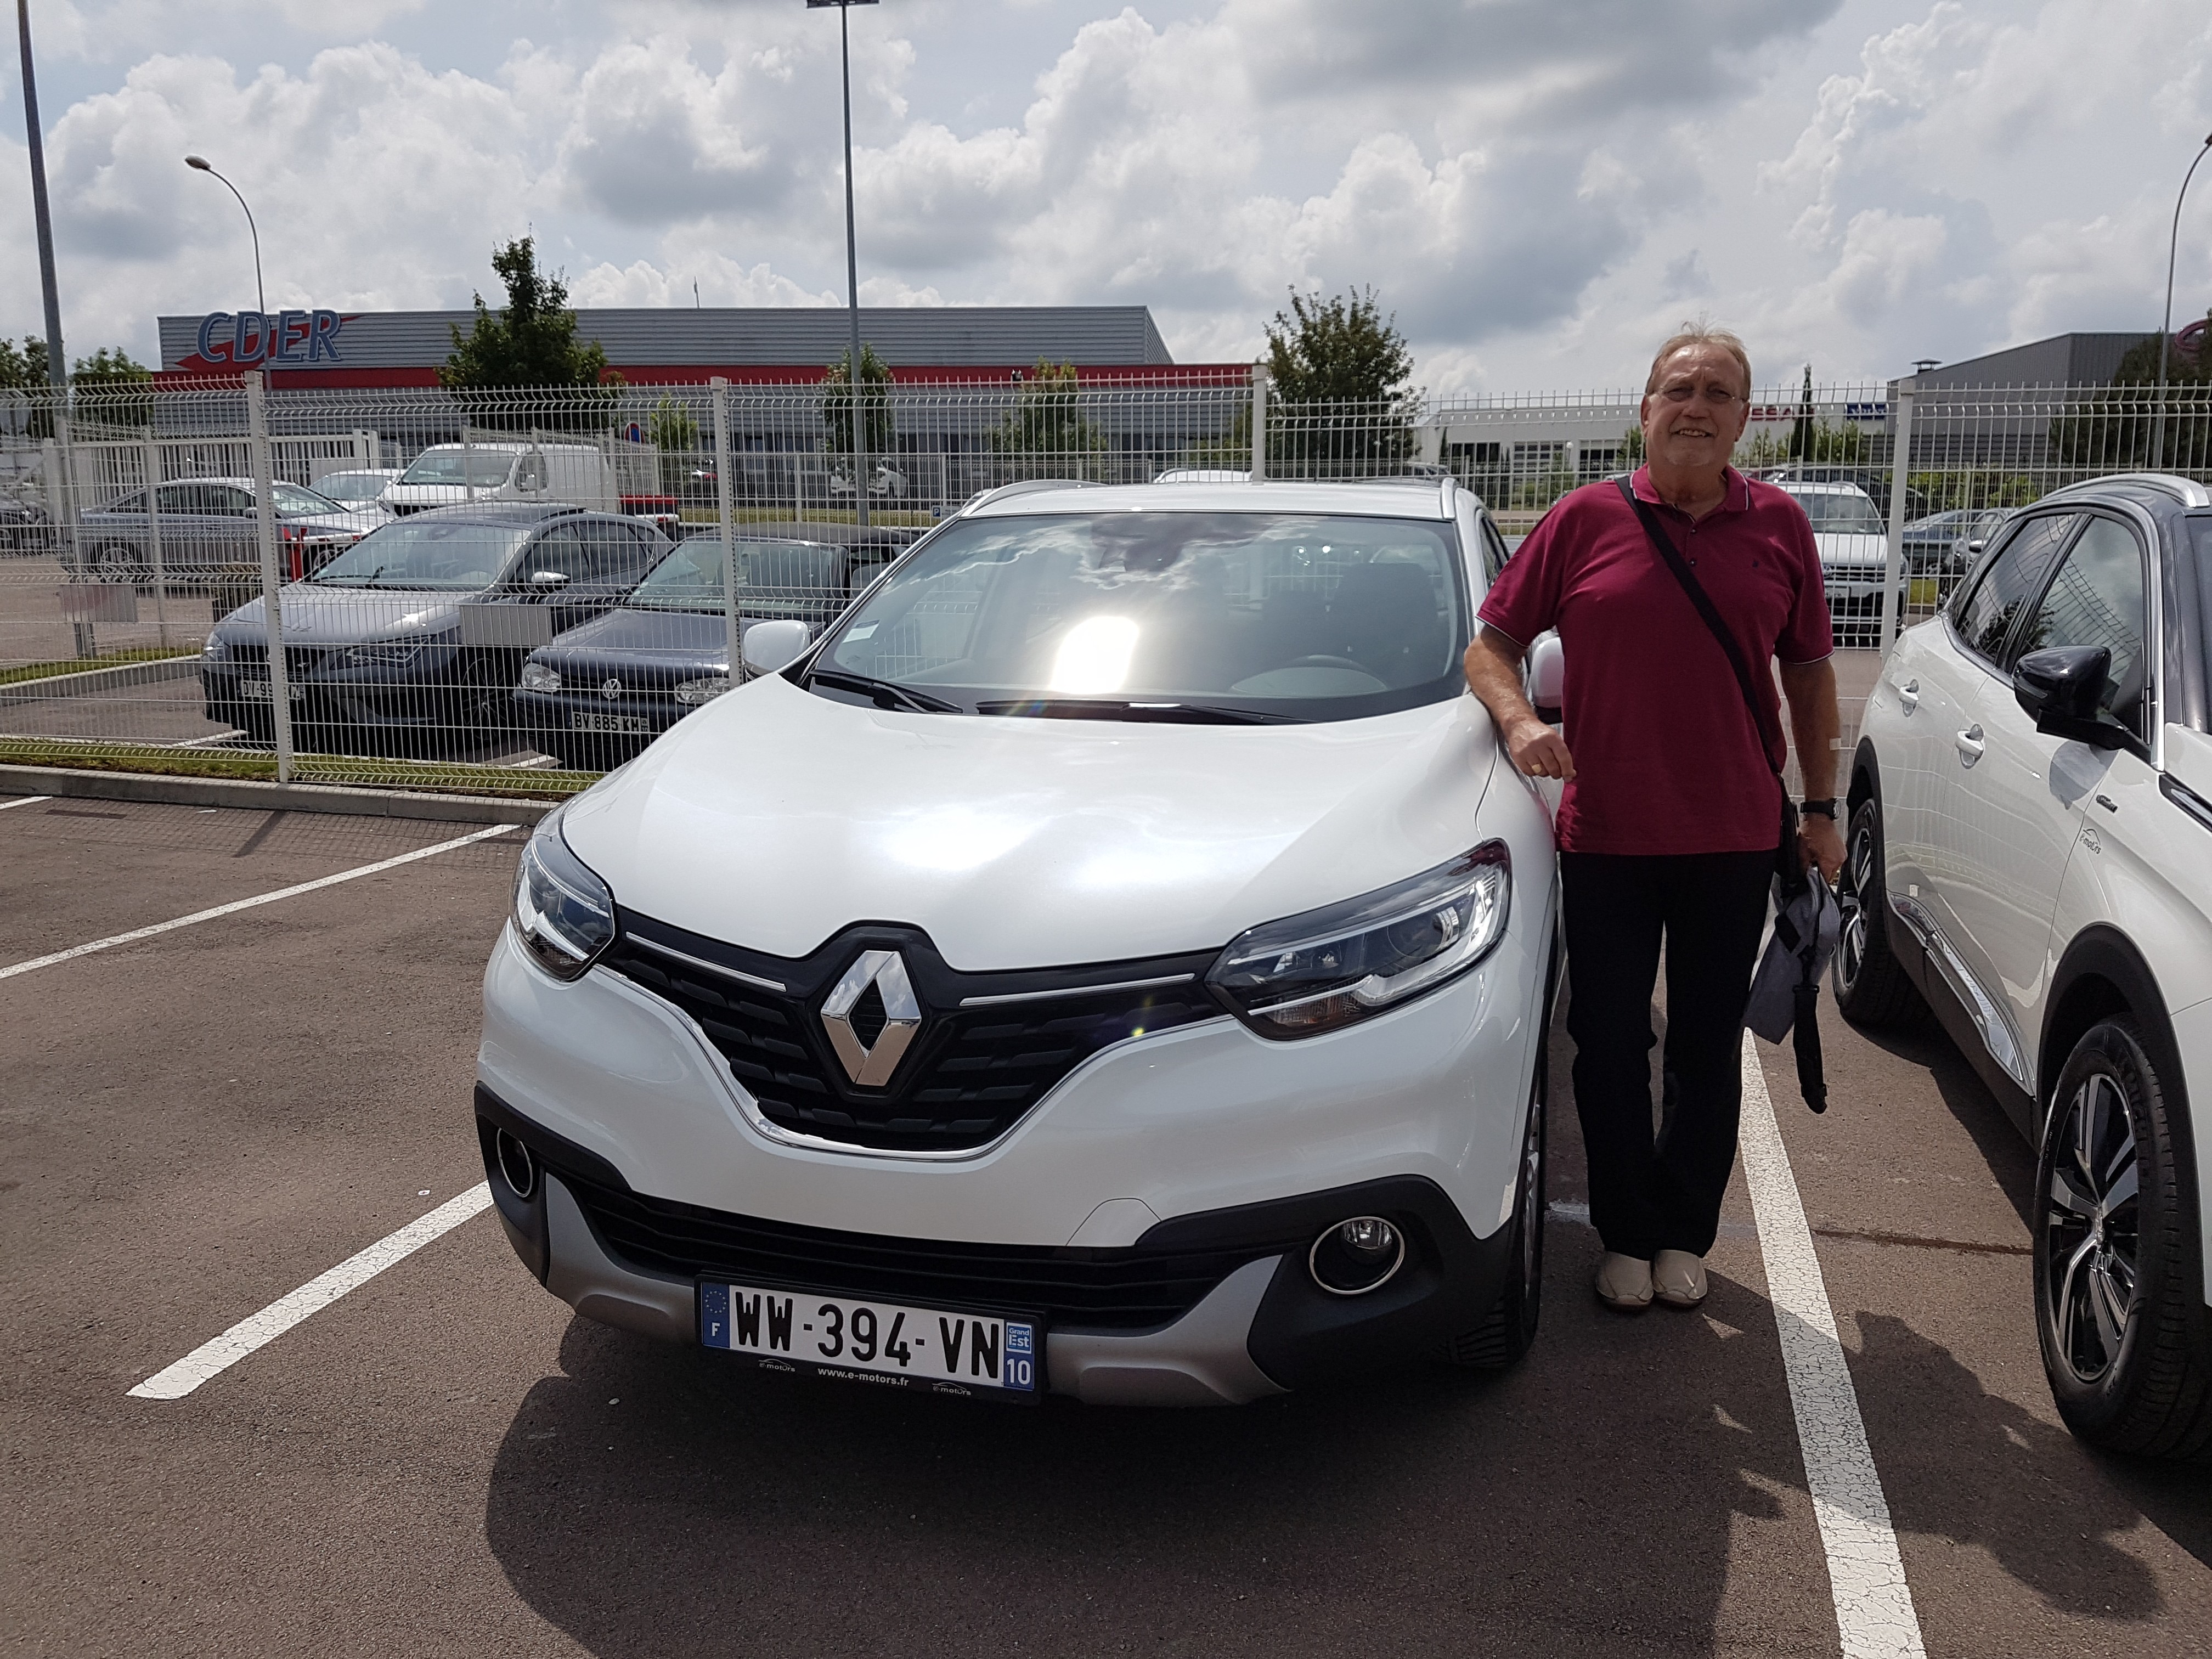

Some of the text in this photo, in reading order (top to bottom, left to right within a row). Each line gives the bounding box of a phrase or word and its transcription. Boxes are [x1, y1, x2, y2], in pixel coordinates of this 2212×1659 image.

[196, 309, 342, 363] CDER
[712, 1322, 720, 1336] F
[1008, 1328, 1029, 1336] Grand
[1008, 1334, 1029, 1348] Est
[817, 1368, 909, 1386] www.e-motors.fr
[1007, 1358, 1031, 1385] 10
